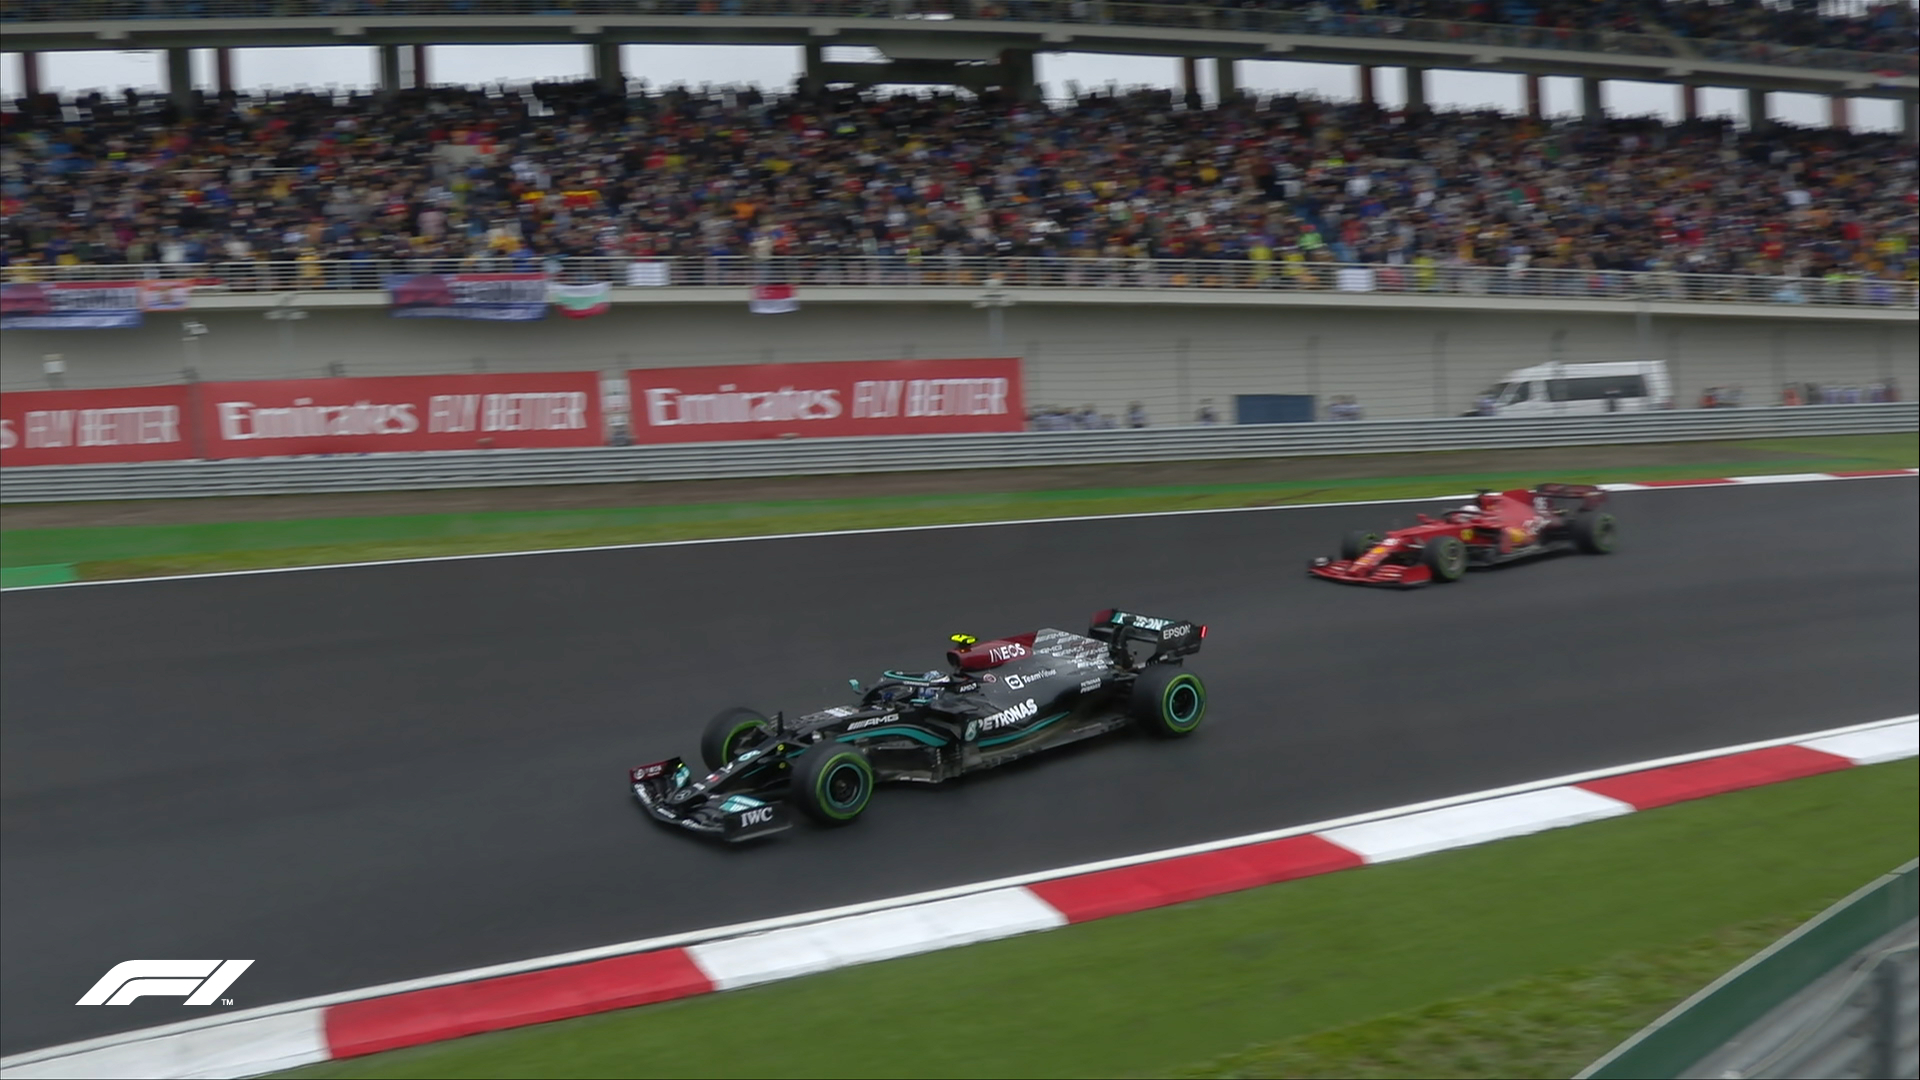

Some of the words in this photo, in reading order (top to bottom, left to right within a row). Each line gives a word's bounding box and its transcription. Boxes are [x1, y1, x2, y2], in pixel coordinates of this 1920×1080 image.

[216, 397, 419, 440] Emirates
[428, 393, 480, 433] FLY
[481, 391, 587, 432] BETTER
[644, 383, 843, 426] Emirates
[852, 379, 905, 418] FLY
[904, 377, 1008, 417] BETTER
[25, 408, 77, 449] FLY
[76, 405, 181, 447] BETTER
[1162, 623, 1191, 640] EPSON
[989, 643, 1026, 663] INEOS
[864, 712, 899, 728] AMG
[978, 698, 1038, 732] PETRONAS
[741, 806, 774, 828] IWC
